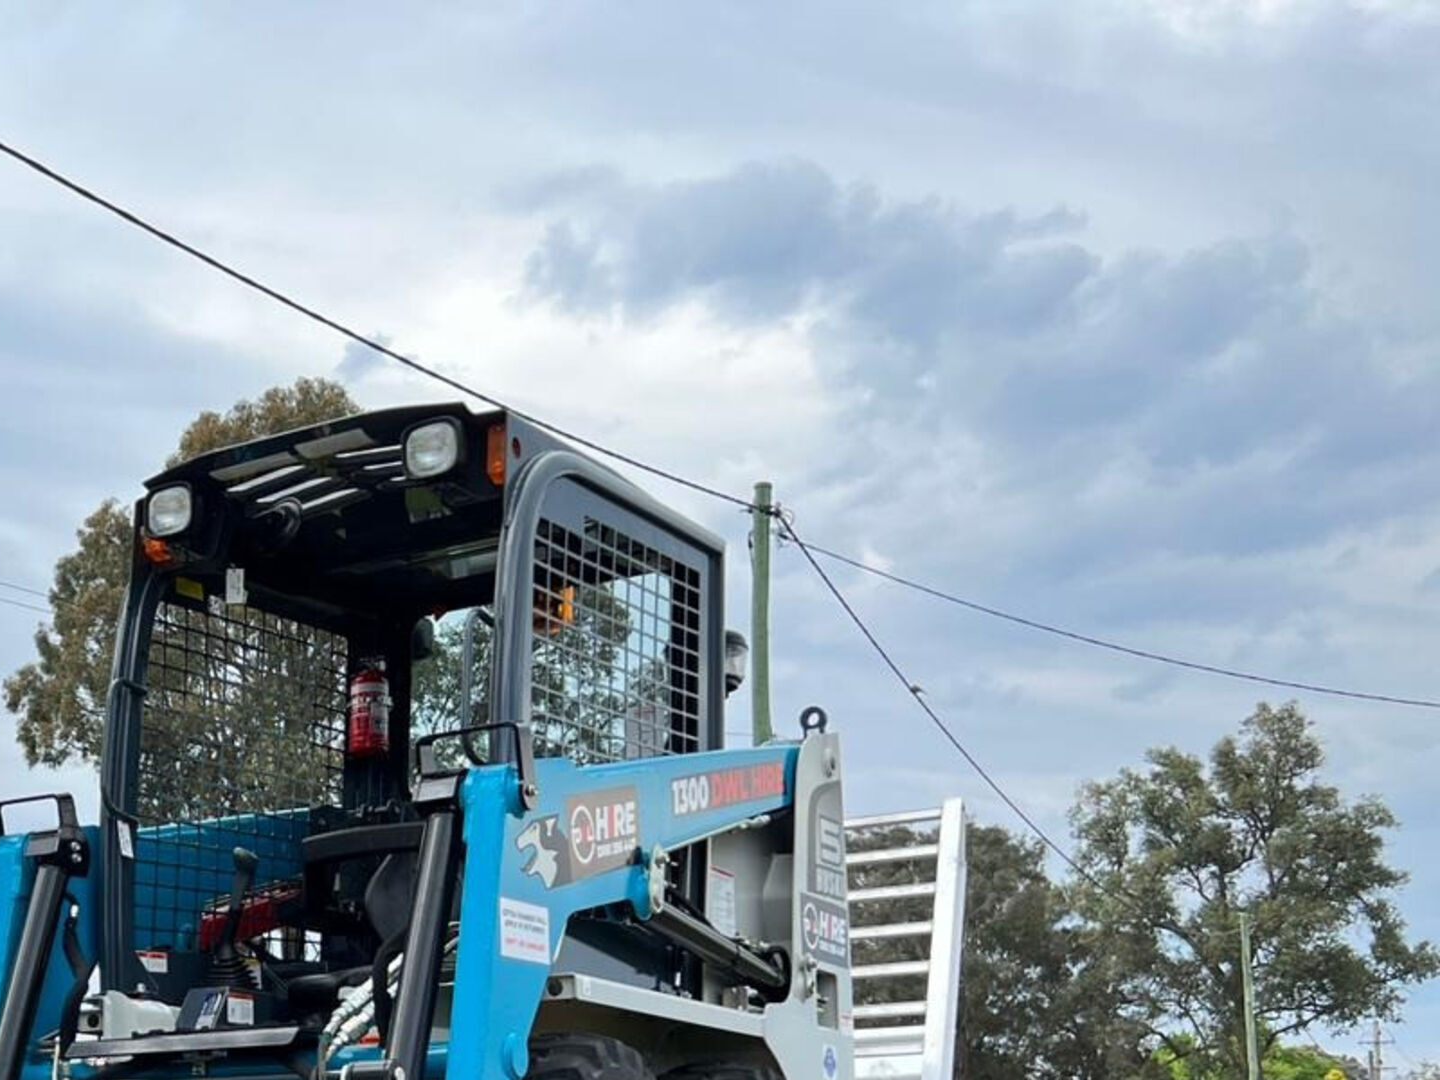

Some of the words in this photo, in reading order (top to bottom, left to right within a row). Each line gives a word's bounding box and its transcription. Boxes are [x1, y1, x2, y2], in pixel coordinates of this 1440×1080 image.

[672, 775, 709, 815] 1300
[595, 801, 637, 842] HIRE
[818, 910, 847, 945] HIRE
